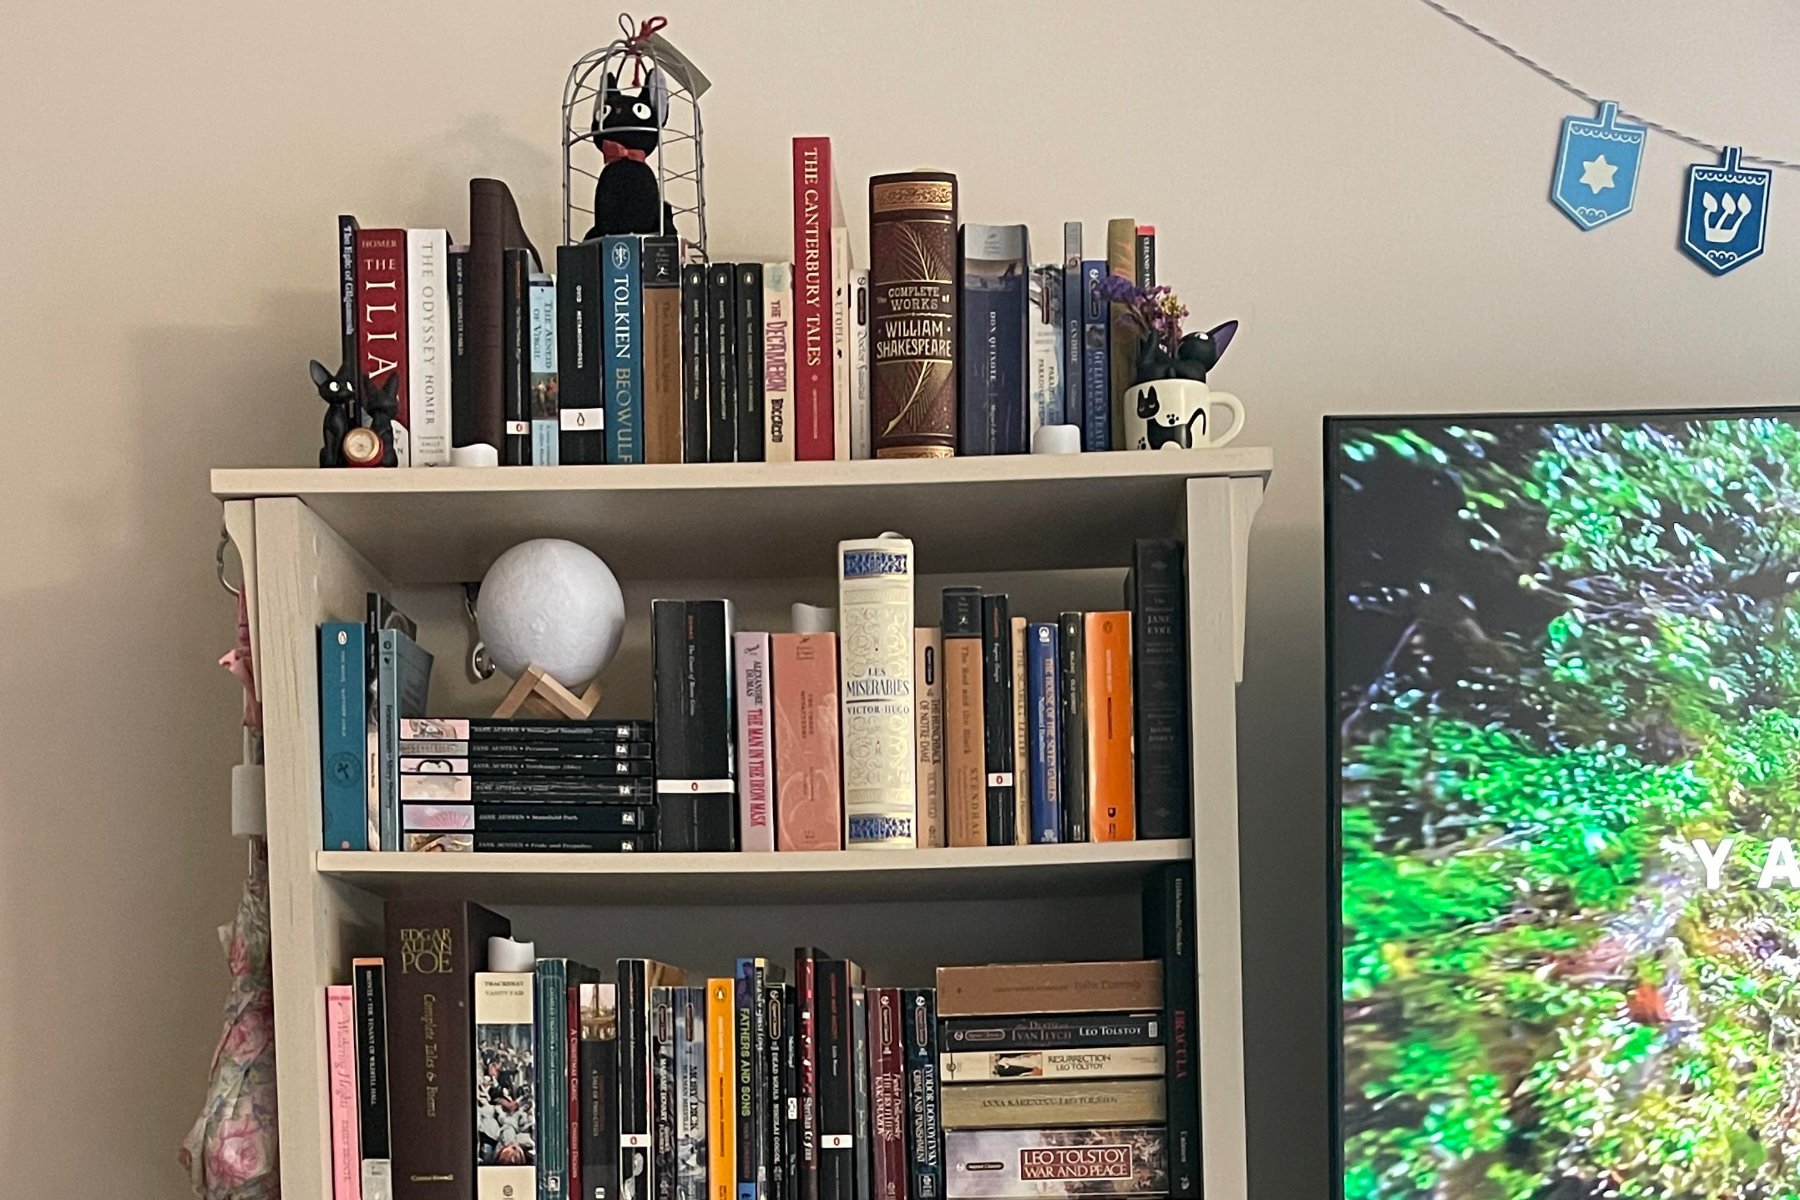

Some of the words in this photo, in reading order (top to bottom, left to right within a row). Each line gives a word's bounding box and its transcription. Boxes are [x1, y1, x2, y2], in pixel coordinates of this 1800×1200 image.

[803, 147, 819, 185] THE
[1702, 191, 1752, 243] ש
[422, 242, 433, 277] THE
[804, 189, 821, 308] CANTERBURY
[364, 260, 396, 271] THE
[888, 287, 940, 297] COMPLETE
[891, 298, 938, 310] WORKS
[614, 274, 630, 358] TOLKIEN
[770, 300, 781, 318] THE
[989, 311, 997, 331] DON
[365, 280, 398, 379] ILIA
[422, 286, 435, 365] ODYSSEY
[835, 302, 843, 344] UTOPIA
[886, 320, 943, 338] WILLIAM
[806, 313, 821, 366] TALES
[877, 338, 952, 358] SHAKESPEARE
[765, 320, 787, 391] DECAMERON
[988, 336, 997, 382] QUIXOTE
[425, 375, 435, 425] HOMER
[616, 368, 632, 463] BEOWULF
[746, 669, 754, 697] DUMAS
[753, 661, 763, 705] ALEXANDRE
[747, 708, 763, 726] THE
[748, 728, 764, 748] MAN
[749, 749, 764, 759] IN
[749, 761, 764, 778] THE
[750, 780, 765, 801] IRON
[970, 767, 979, 838] STENDHAL
[750, 803, 766, 827] MASK
[400, 928, 451, 941] EDGAR
[401, 950, 453, 974] POE
[421, 994, 436, 1039] Complete
[740, 1007, 750, 1057] FATHERS
[1080, 1027, 1098, 1036] LEO
[1102, 1026, 1141, 1035] TOLSTOY
[425, 1044, 437, 1068] Tales
[1048, 1054, 1111, 1064] RESURRECTION
[741, 1061, 751, 1084] AND
[913, 1070, 923, 1093] CRIME
[924, 1064, 935, 1102] FYODOR
[426, 1086, 438, 1117] Poems
[741, 1087, 751, 1116] SONS
[914, 1095, 924, 1112] AND
[925, 1104, 937, 1166] DOSTOYEVSKY
[1024, 1150, 1054, 1165] LEO
[1059, 1148, 1128, 1164] TOLSTOY
[1023, 1166, 1053, 1178] WAR
[1058, 1165, 1088, 1177] AND
[1090, 1164, 1127, 1176] PEACE
